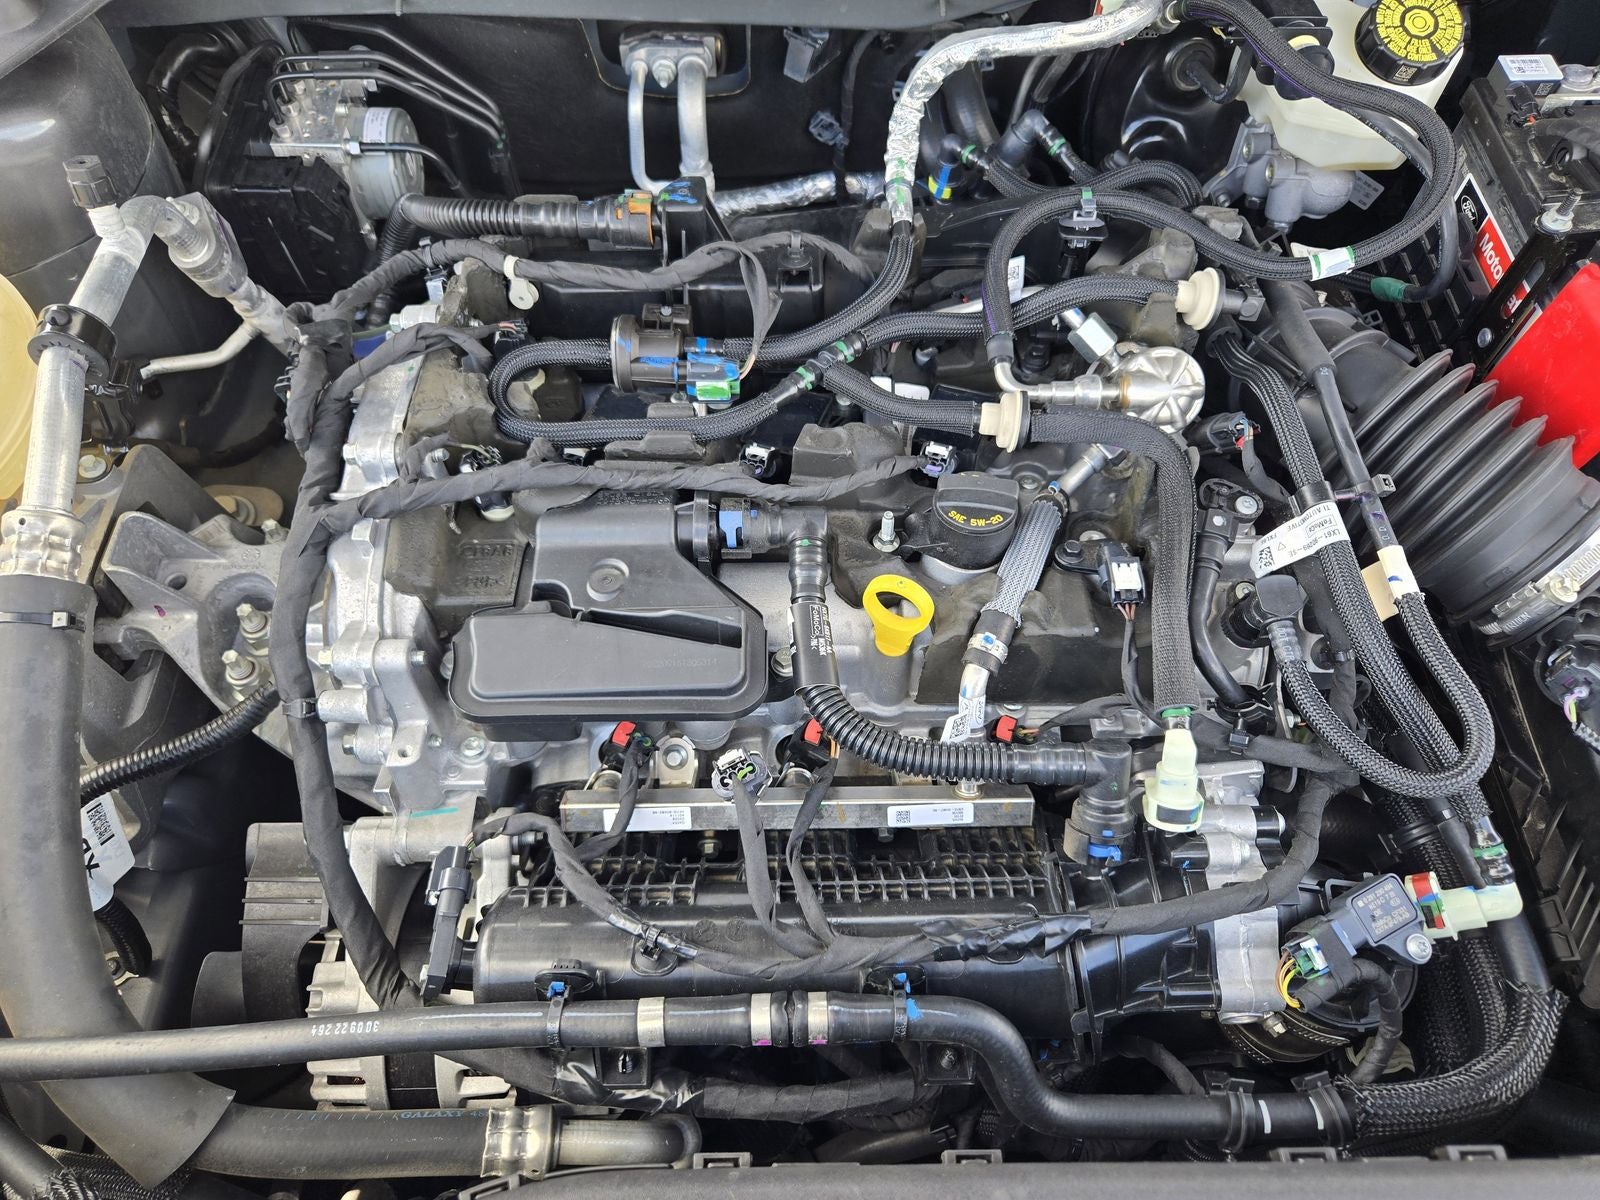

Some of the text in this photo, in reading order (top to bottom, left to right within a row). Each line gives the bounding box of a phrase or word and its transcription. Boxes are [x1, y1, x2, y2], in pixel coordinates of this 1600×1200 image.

[1406, 52, 1438, 62] CONTAINER
[948, 510, 1004, 527] SAE 5W-20
[1287, 506, 1322, 533] AUTOMOTIVE
[812, 605, 821, 636] FoMoCo
[401, 1110, 464, 1119] GALAXY
